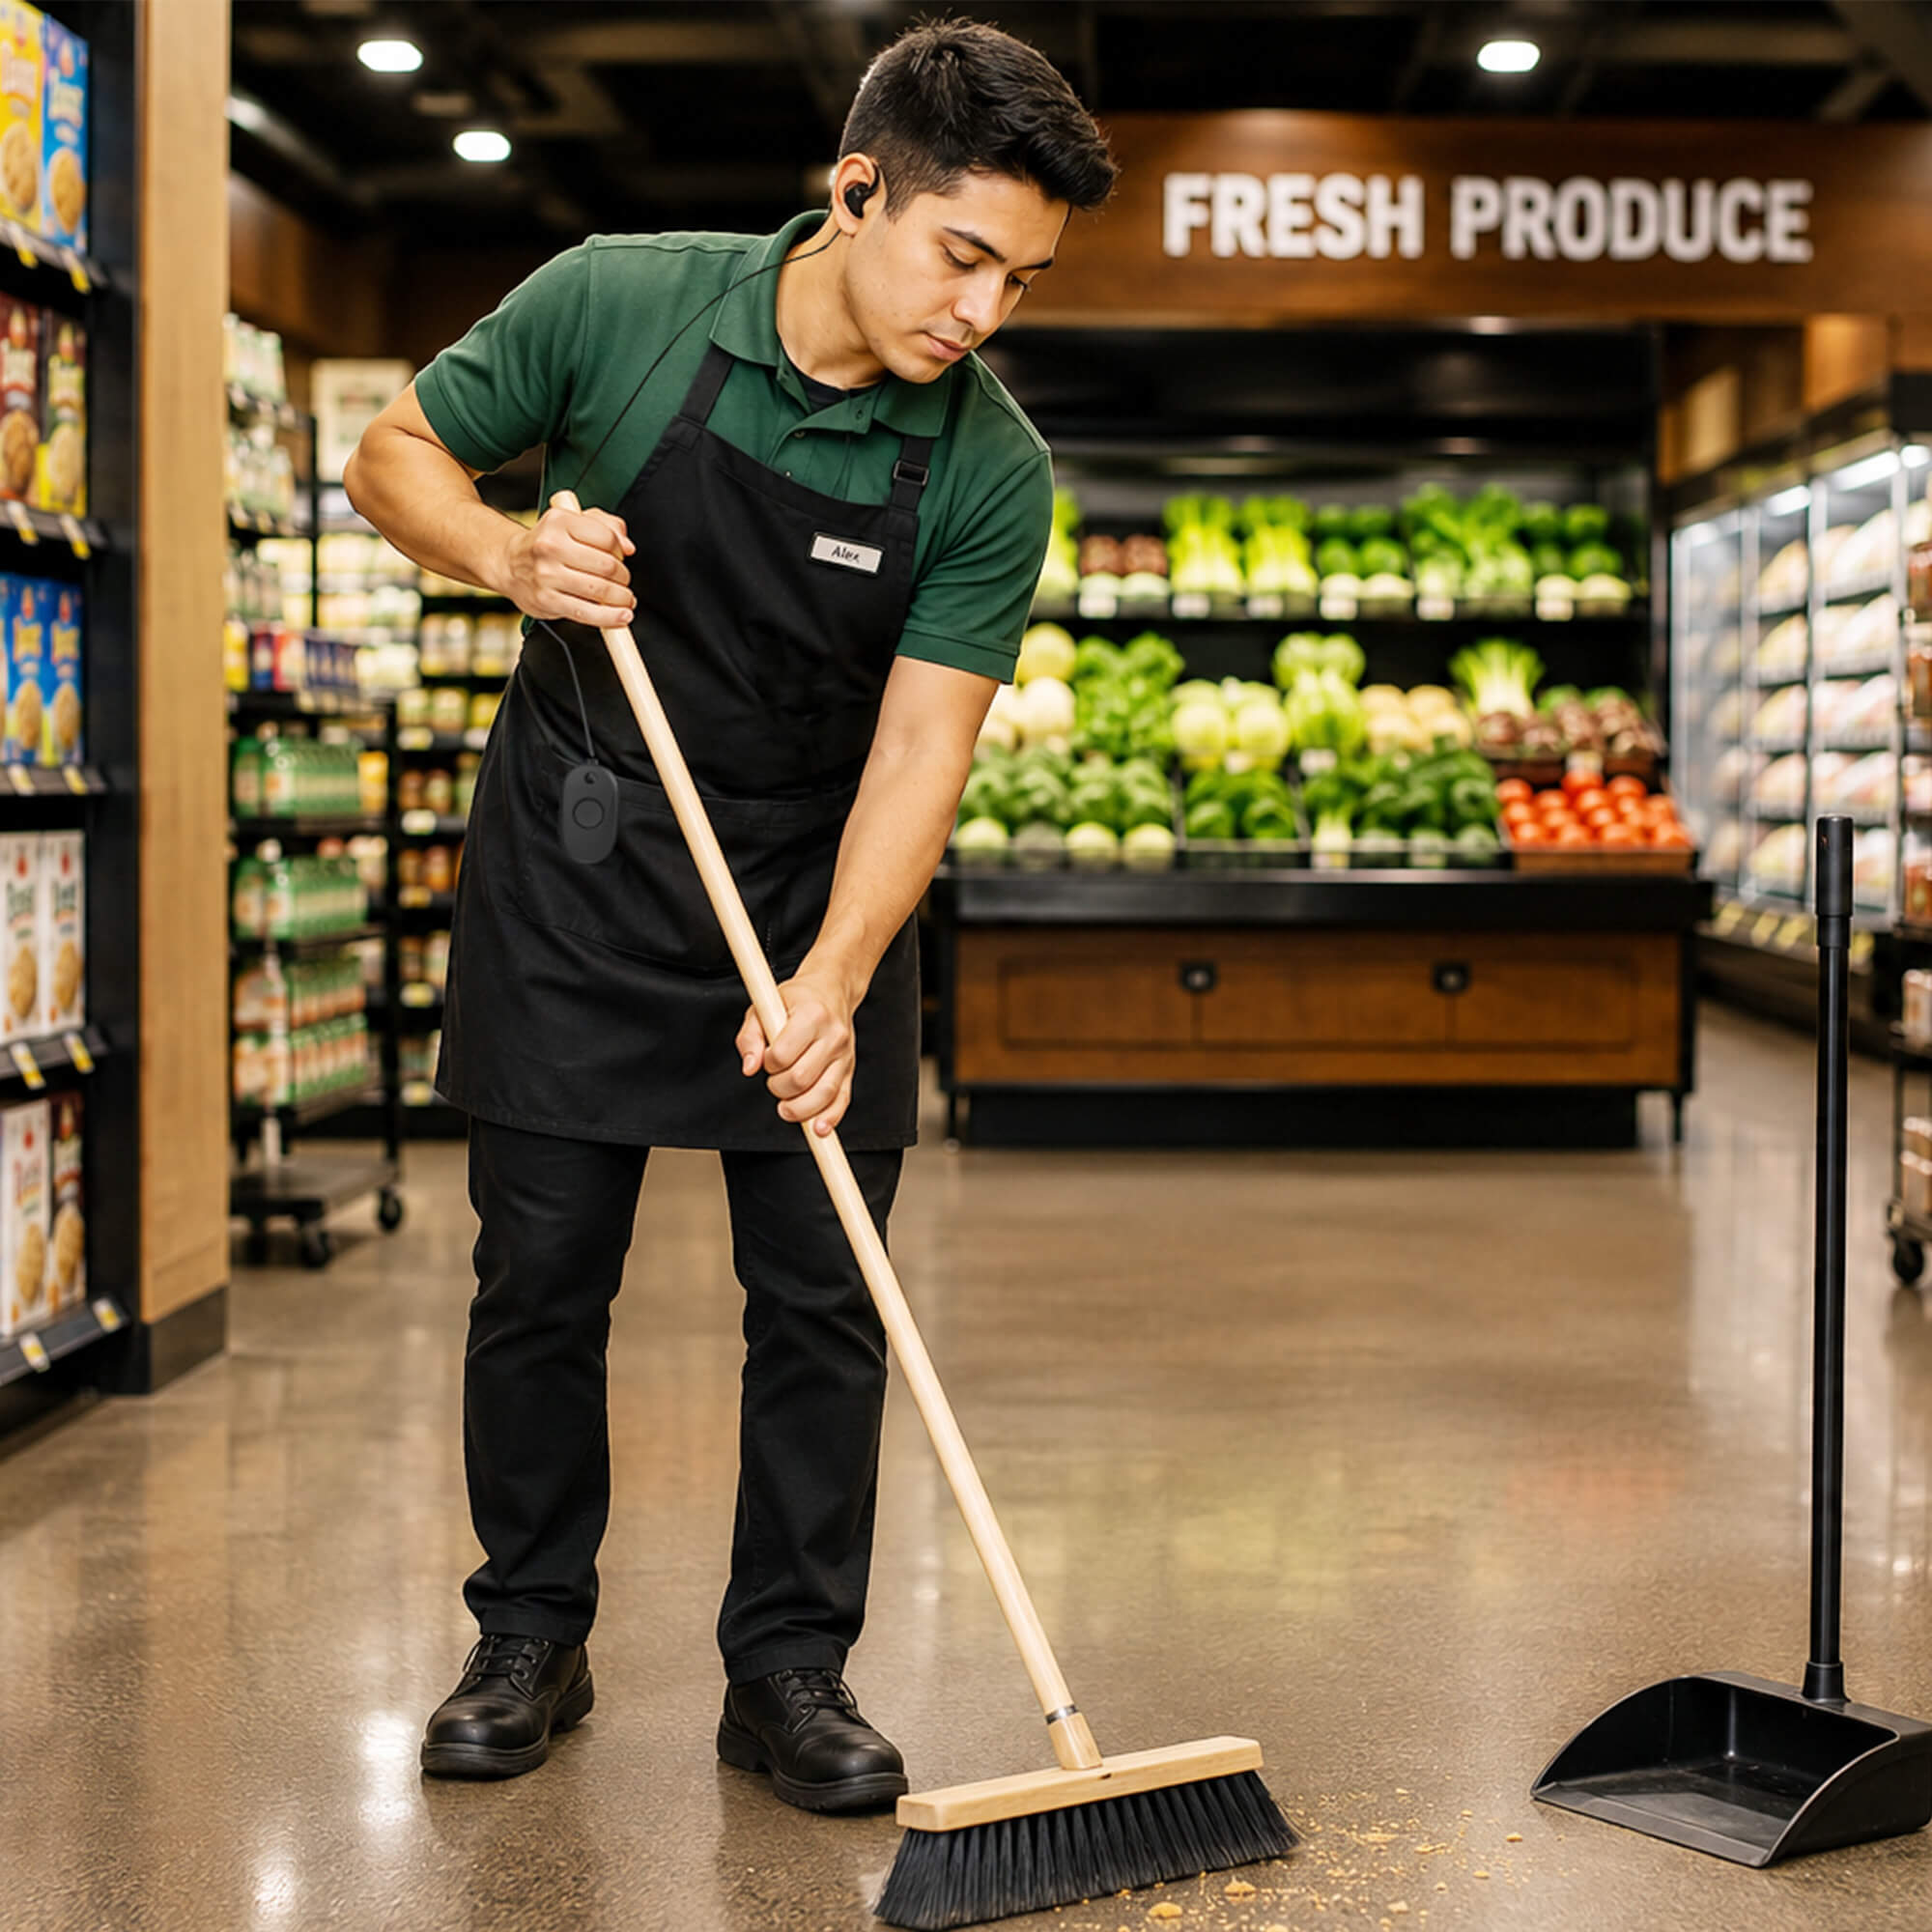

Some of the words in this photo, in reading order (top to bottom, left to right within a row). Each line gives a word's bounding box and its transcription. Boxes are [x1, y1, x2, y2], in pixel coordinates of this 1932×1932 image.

[1163, 173, 1424, 260] FRESH
[1451, 177, 1813, 263] PRODUCE
[831, 545, 861, 563] Alex
